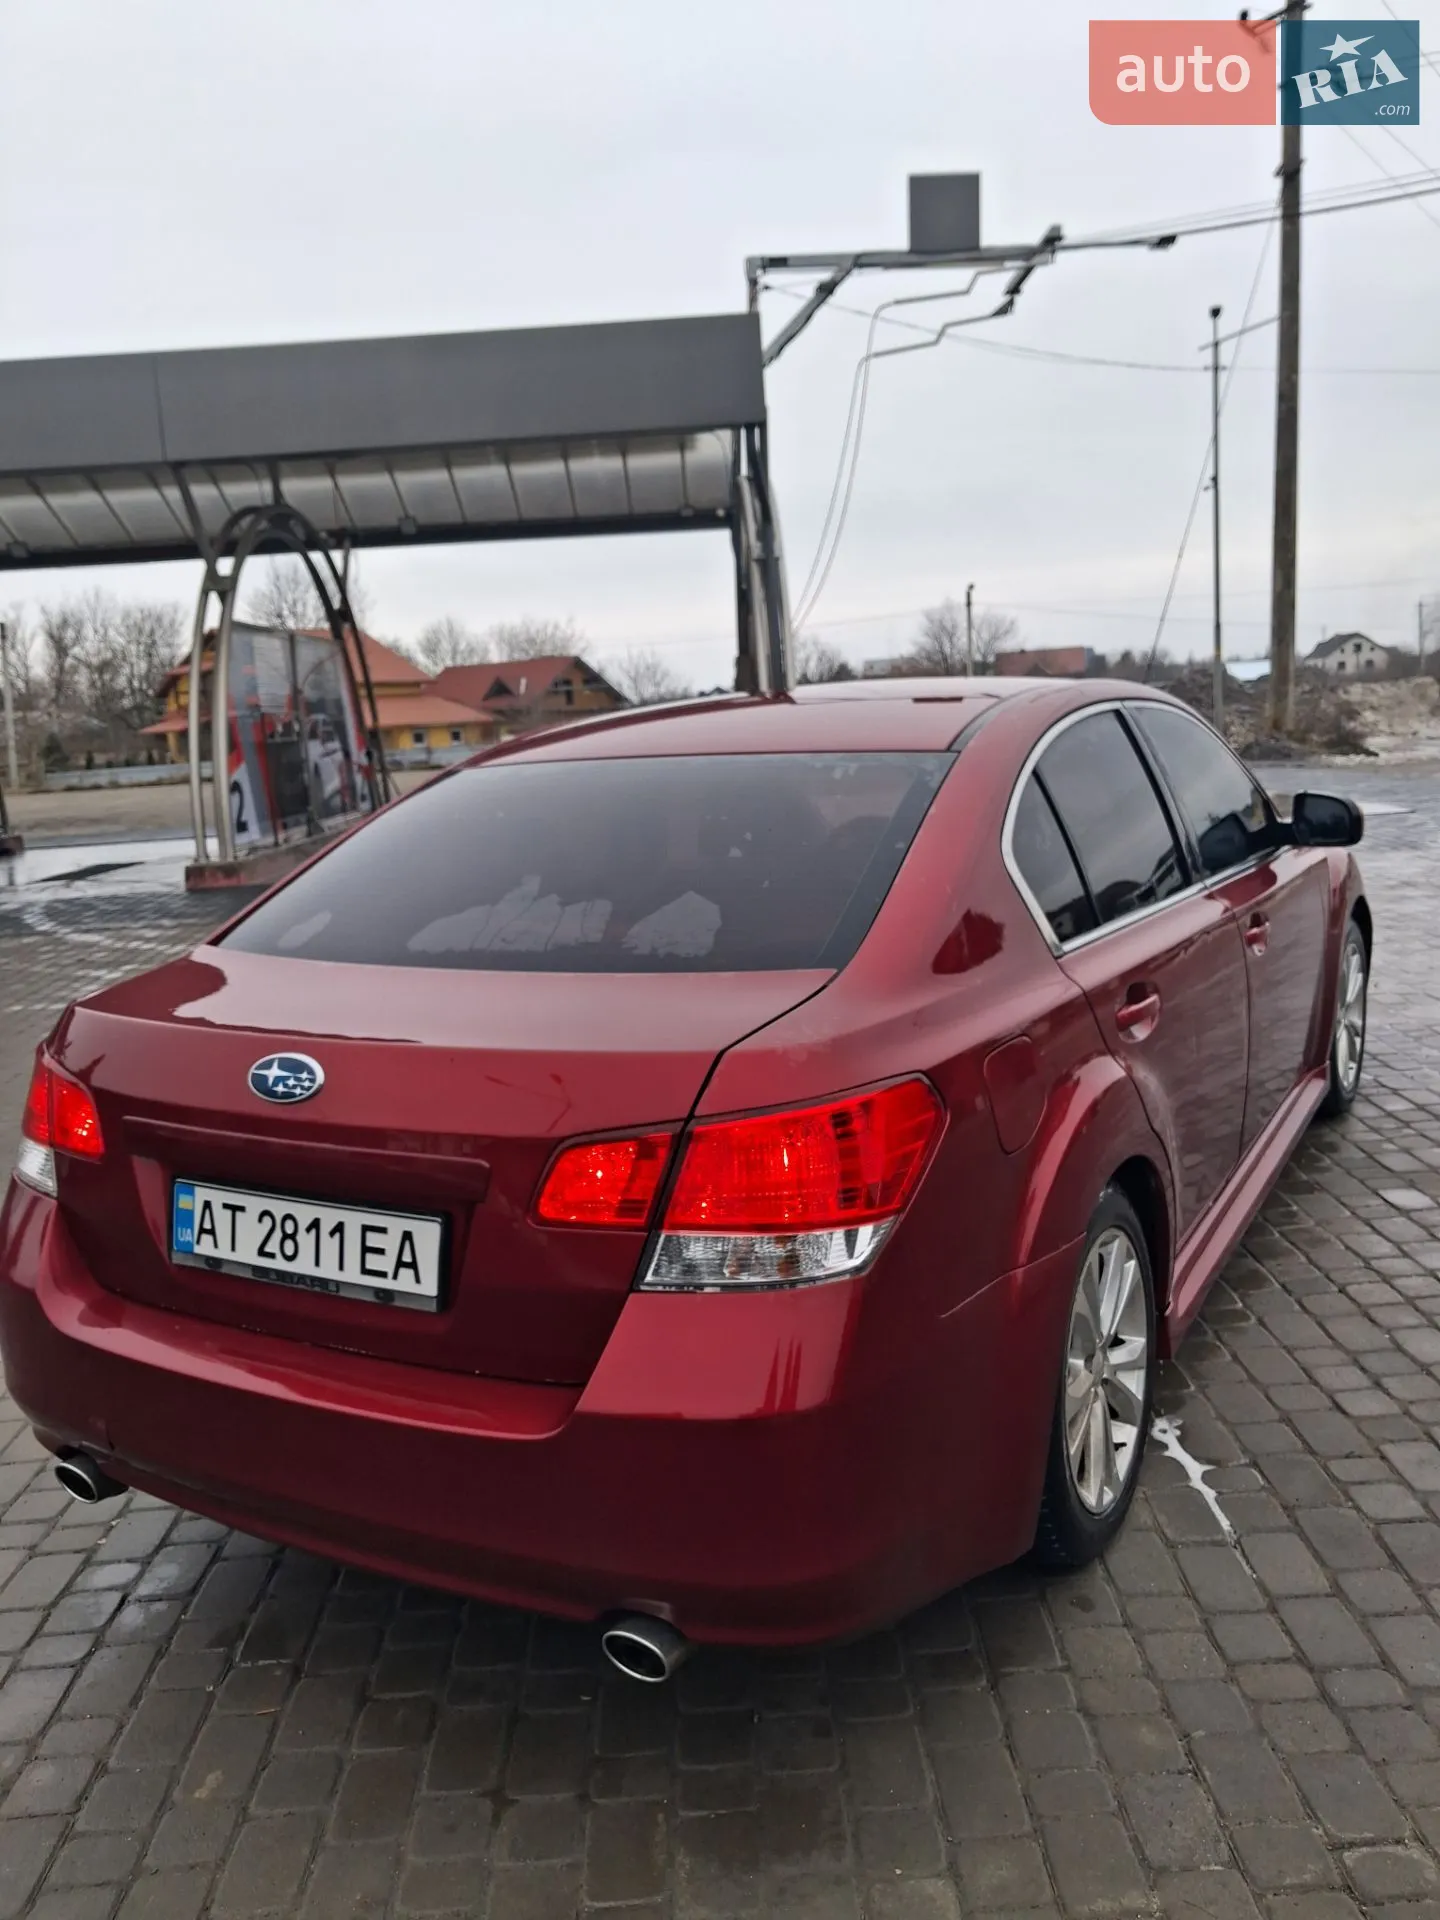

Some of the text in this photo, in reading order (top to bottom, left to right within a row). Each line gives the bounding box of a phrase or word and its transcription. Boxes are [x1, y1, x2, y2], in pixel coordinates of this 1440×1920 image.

[230, 780, 248, 833] 2
[178, 1227, 193, 1243] UA
[196, 1199, 421, 1285] AT 2811 EA
